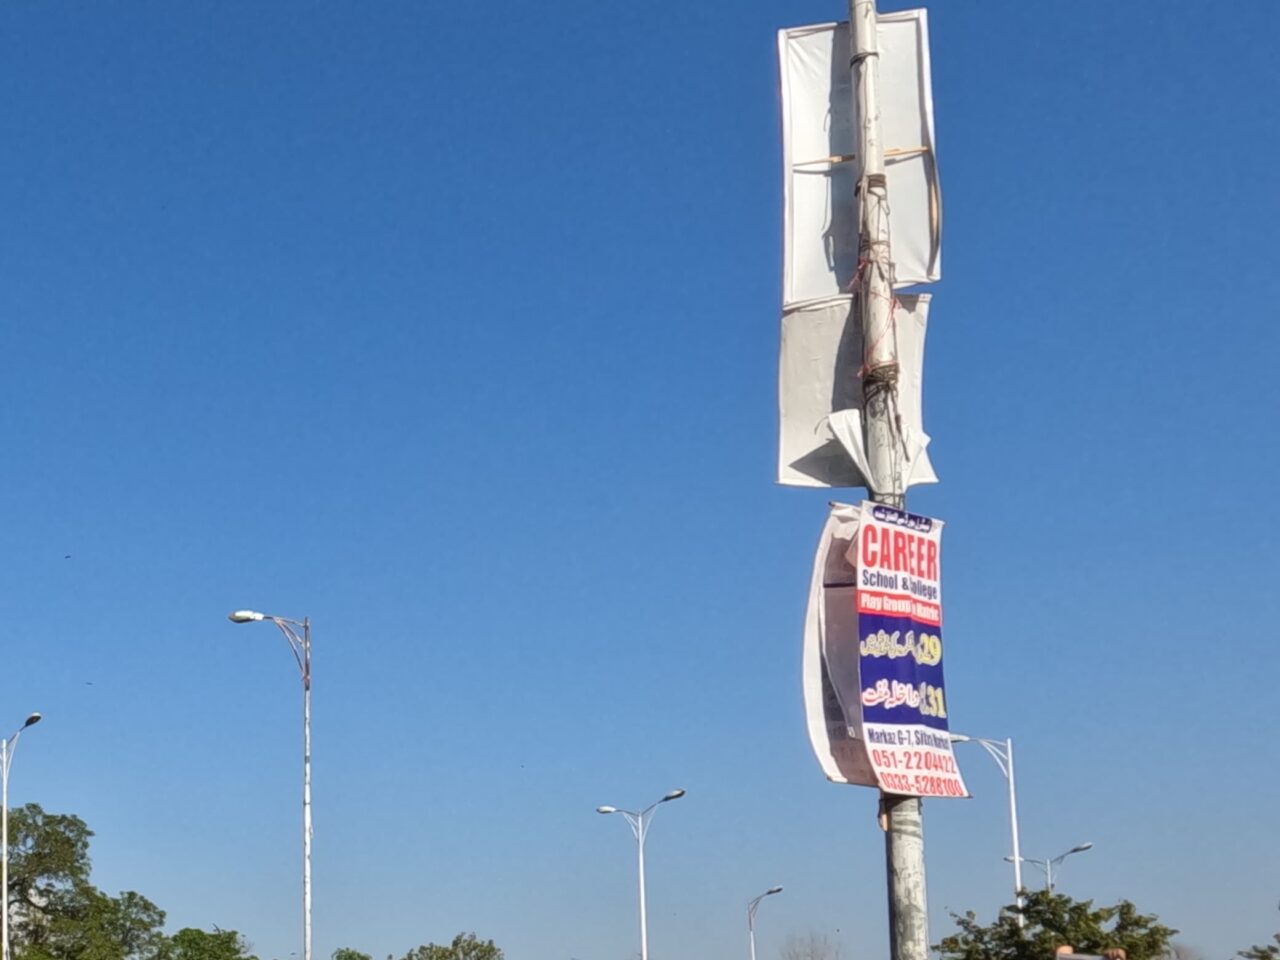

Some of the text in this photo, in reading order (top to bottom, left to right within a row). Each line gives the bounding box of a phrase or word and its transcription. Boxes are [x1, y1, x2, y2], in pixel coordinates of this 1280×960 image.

[862, 524, 937, 582] CAREER
[862, 570, 898, 590] School
[861, 592, 881, 611] Play
[867, 728, 897, 745] Markaz
